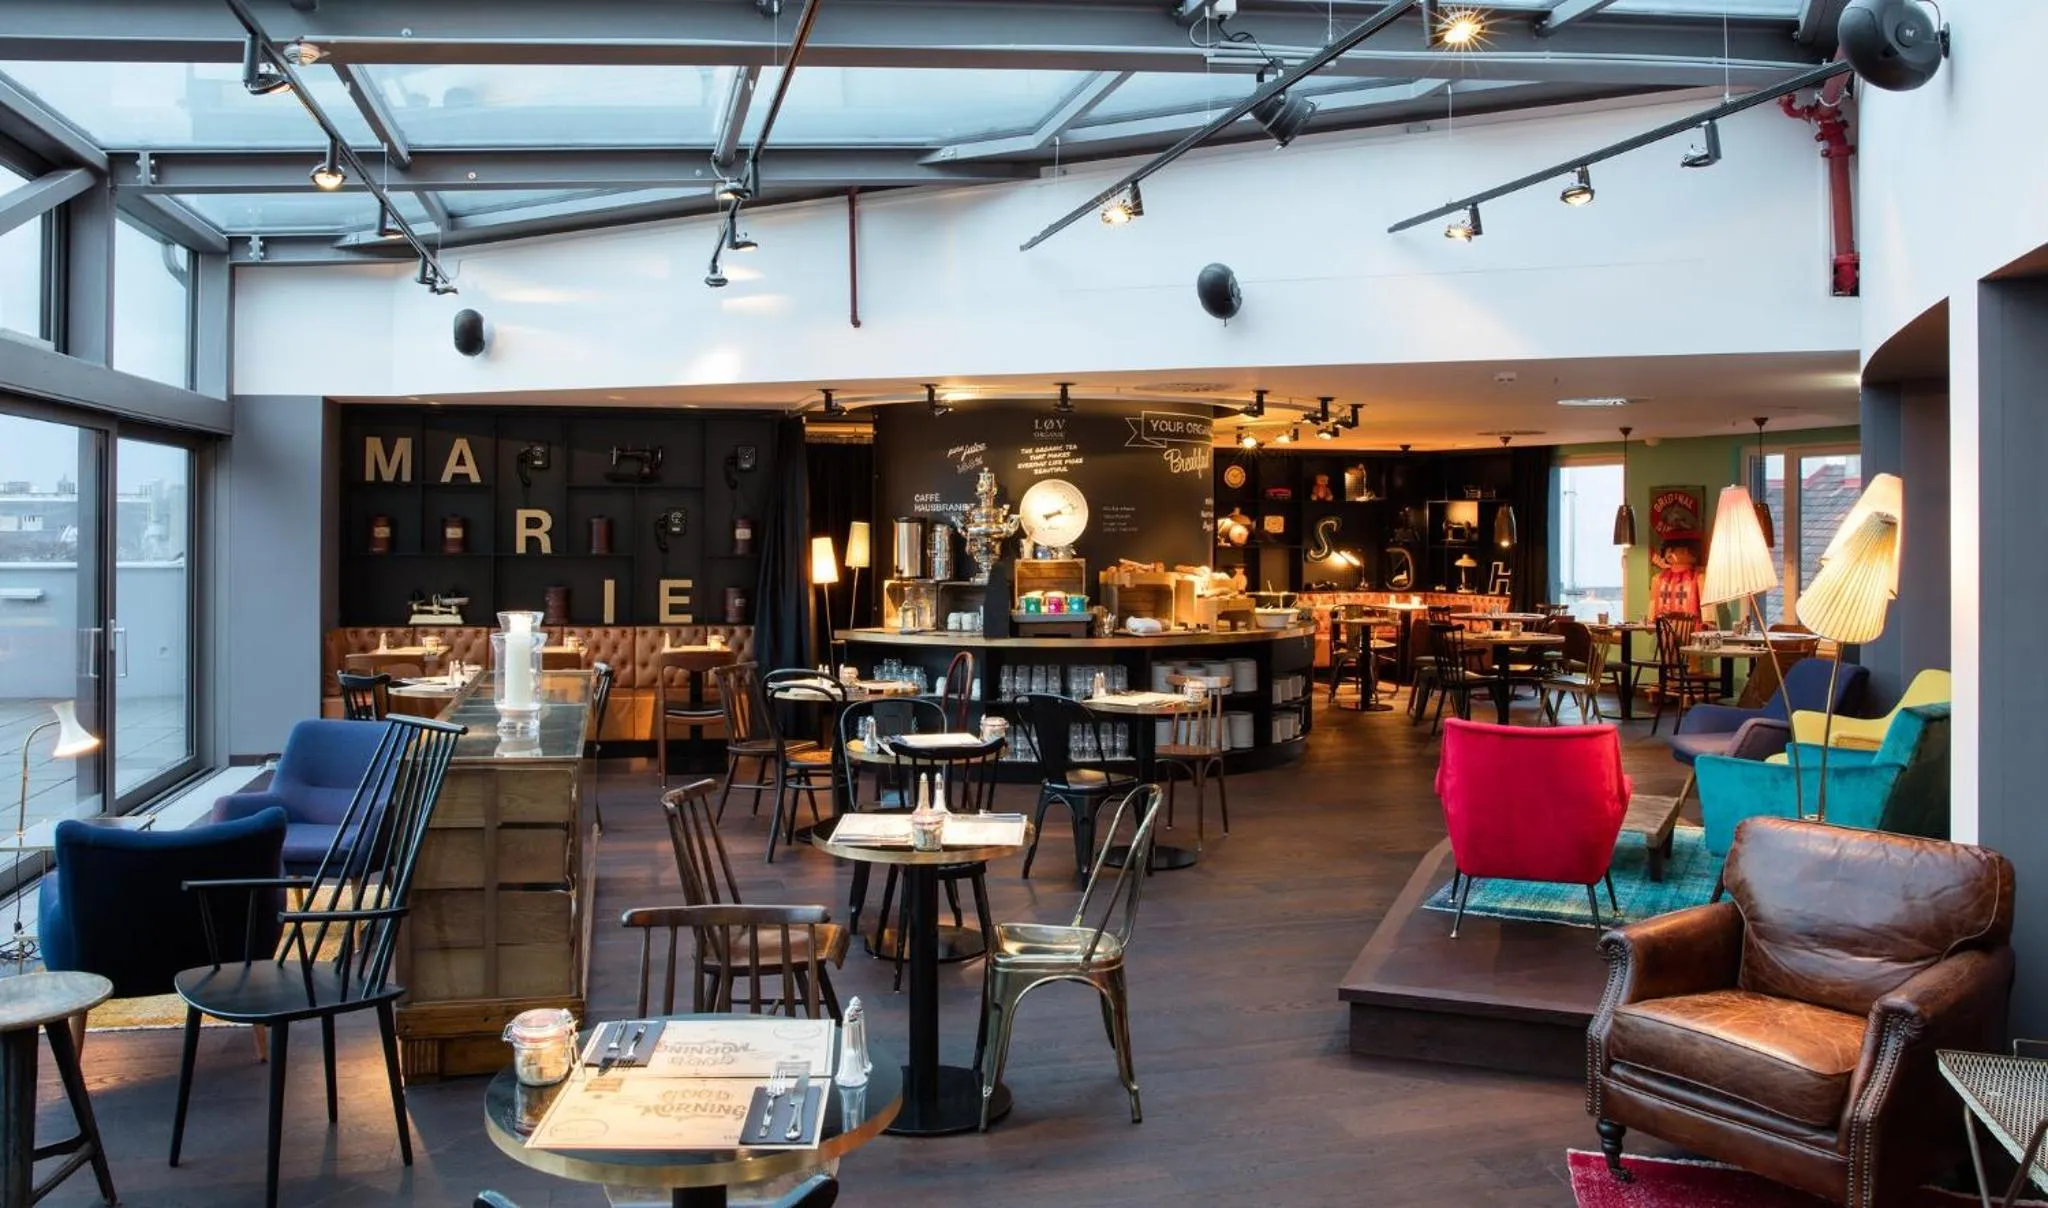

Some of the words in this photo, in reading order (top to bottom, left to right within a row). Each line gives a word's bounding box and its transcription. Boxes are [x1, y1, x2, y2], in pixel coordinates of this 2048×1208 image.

[1149, 419, 1184, 433] YOUR
[1032, 430, 1064, 438] ORGANIC
[1034, 445, 1064, 453] ORGANIC
[1017, 460, 1047, 469] EVERYDAY
[1048, 458, 1063, 466] LIFE
[1064, 456, 1084, 464] MORE
[1029, 453, 1047, 461] THAT
[1047, 451, 1071, 460] MAKES
[1033, 466, 1069, 475] BEAUTIFUL
[1653, 493, 1694, 513] ORIGINAL
[657, 1088, 735, 1102] GOOD
[634, 1102, 748, 1121] MORNING
